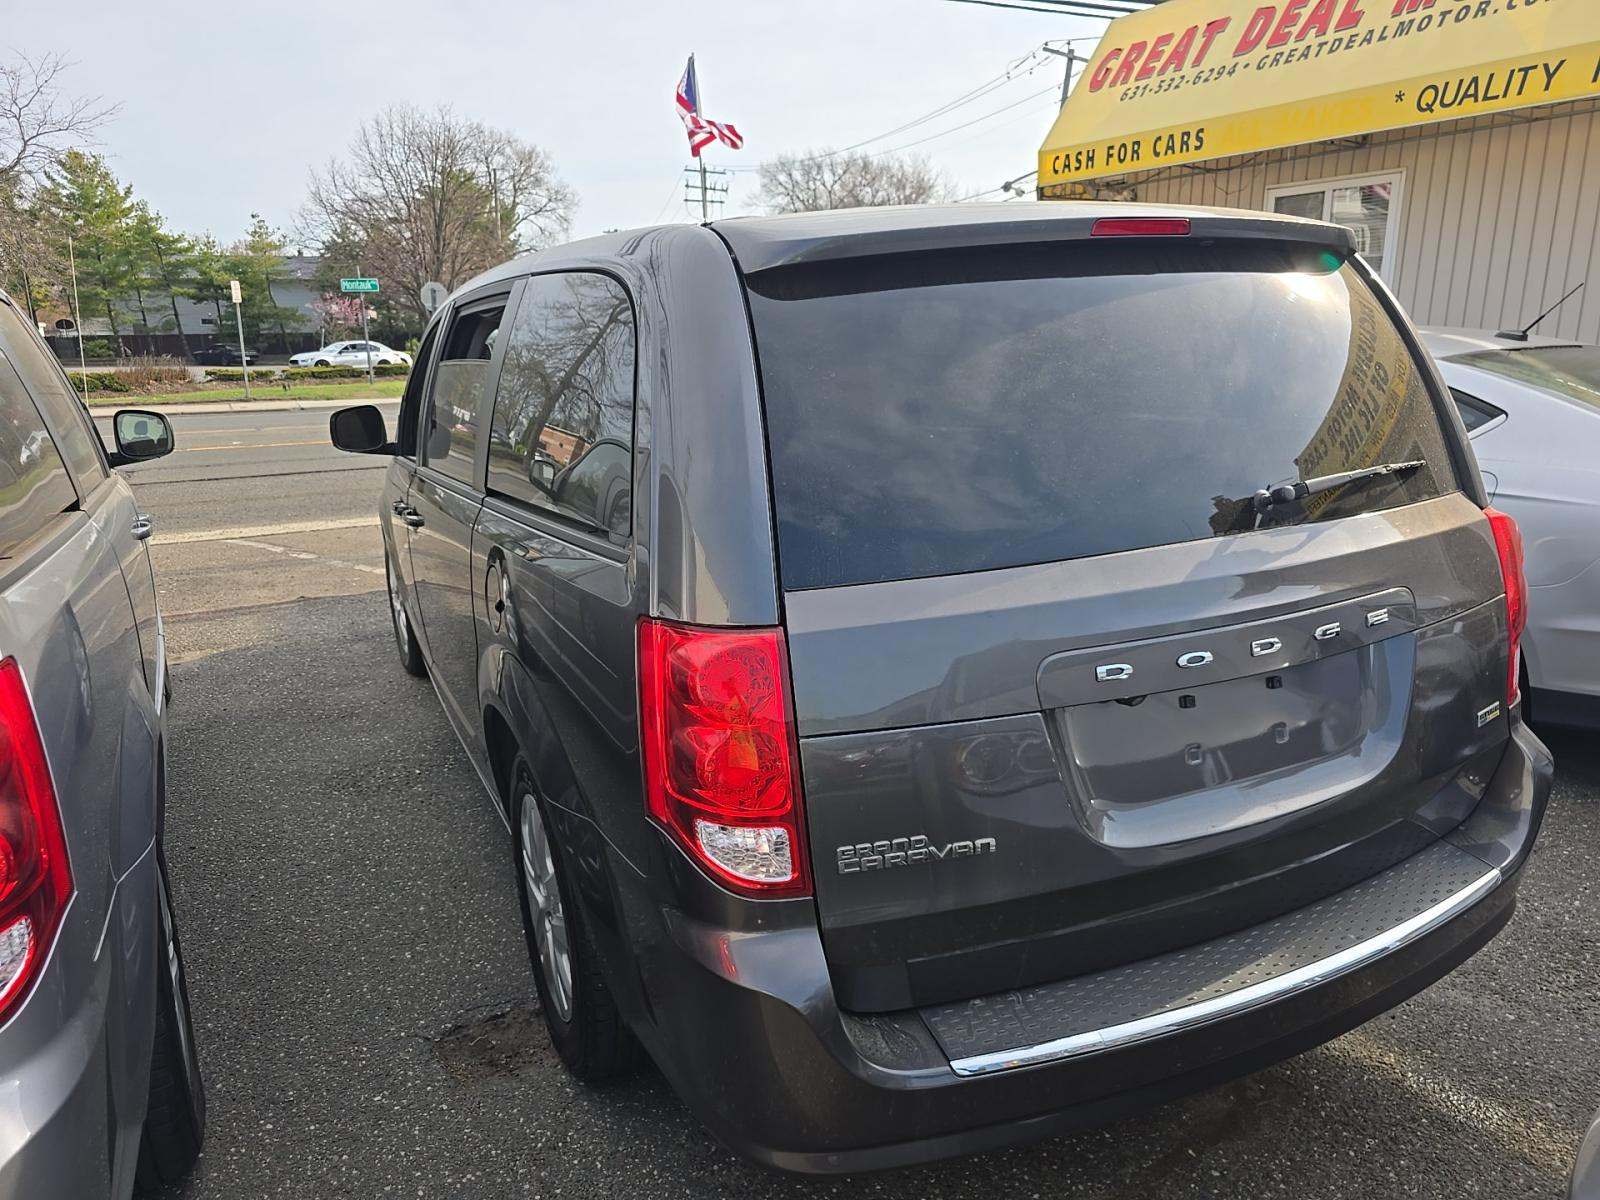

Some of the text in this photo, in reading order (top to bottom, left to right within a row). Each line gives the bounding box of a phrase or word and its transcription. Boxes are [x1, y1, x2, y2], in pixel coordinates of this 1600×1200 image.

[1088, 0, 1365, 93] GREAT DEAL
[1119, 62, 1239, 102] 631-532-6294
[1255, 0, 1550, 71] GREATDEALMOTOR.C
[1416, 59, 1567, 114] QUALITY
[1052, 127, 1205, 175] CASH FOR CARS
[1094, 608, 1391, 682] DODGE
[836, 834, 929, 861] GRAND
[838, 837, 997, 874] CARAVAN
